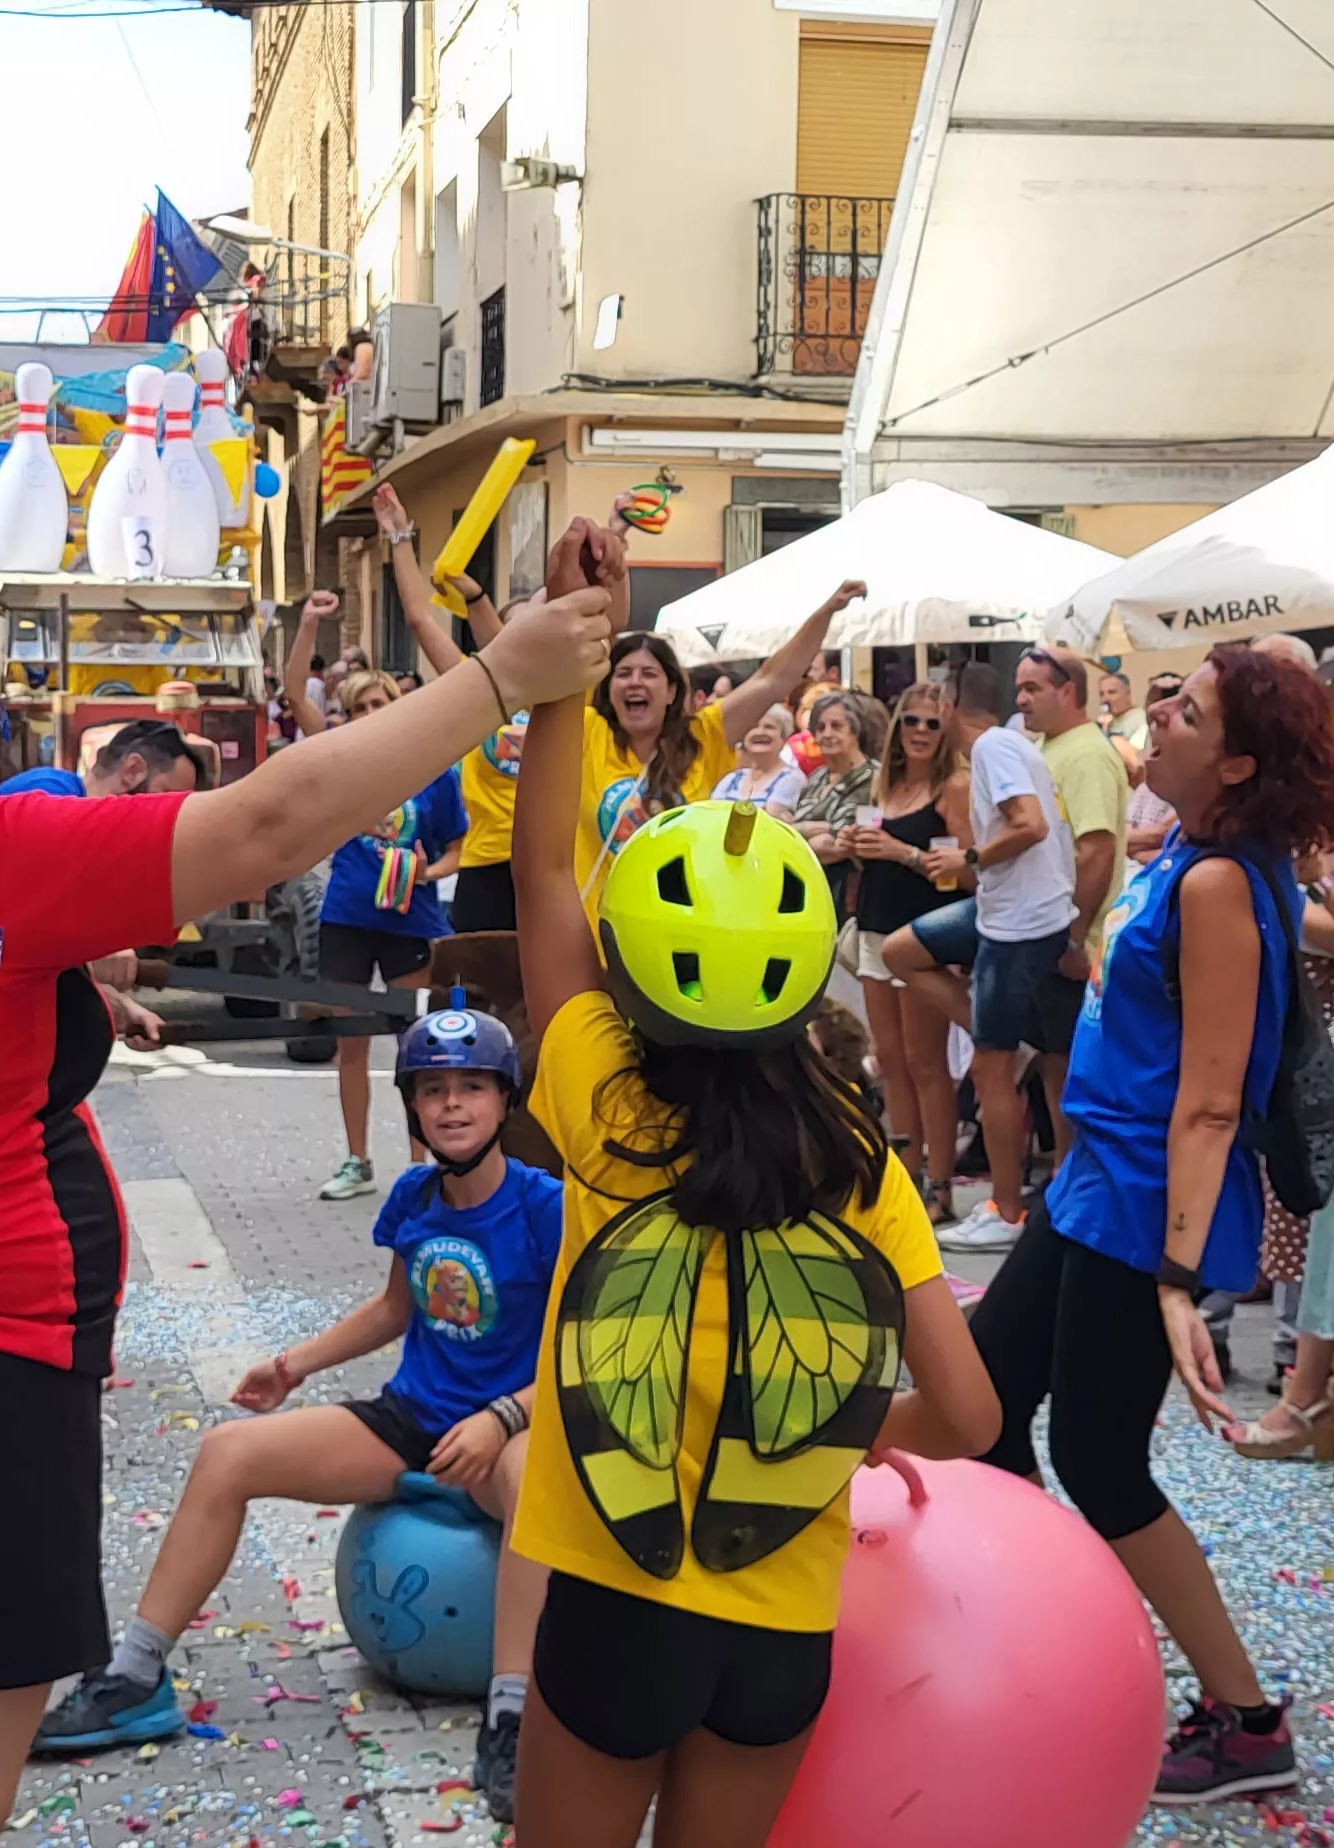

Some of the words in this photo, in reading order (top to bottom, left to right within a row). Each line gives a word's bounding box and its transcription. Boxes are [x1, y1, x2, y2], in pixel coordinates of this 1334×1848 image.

[134, 529, 154, 567] 3
[1183, 594, 1284, 629] AMBAR
[410, 1241, 495, 1295] ALMUDEVAR
[433, 1318, 483, 1341] PRIX
